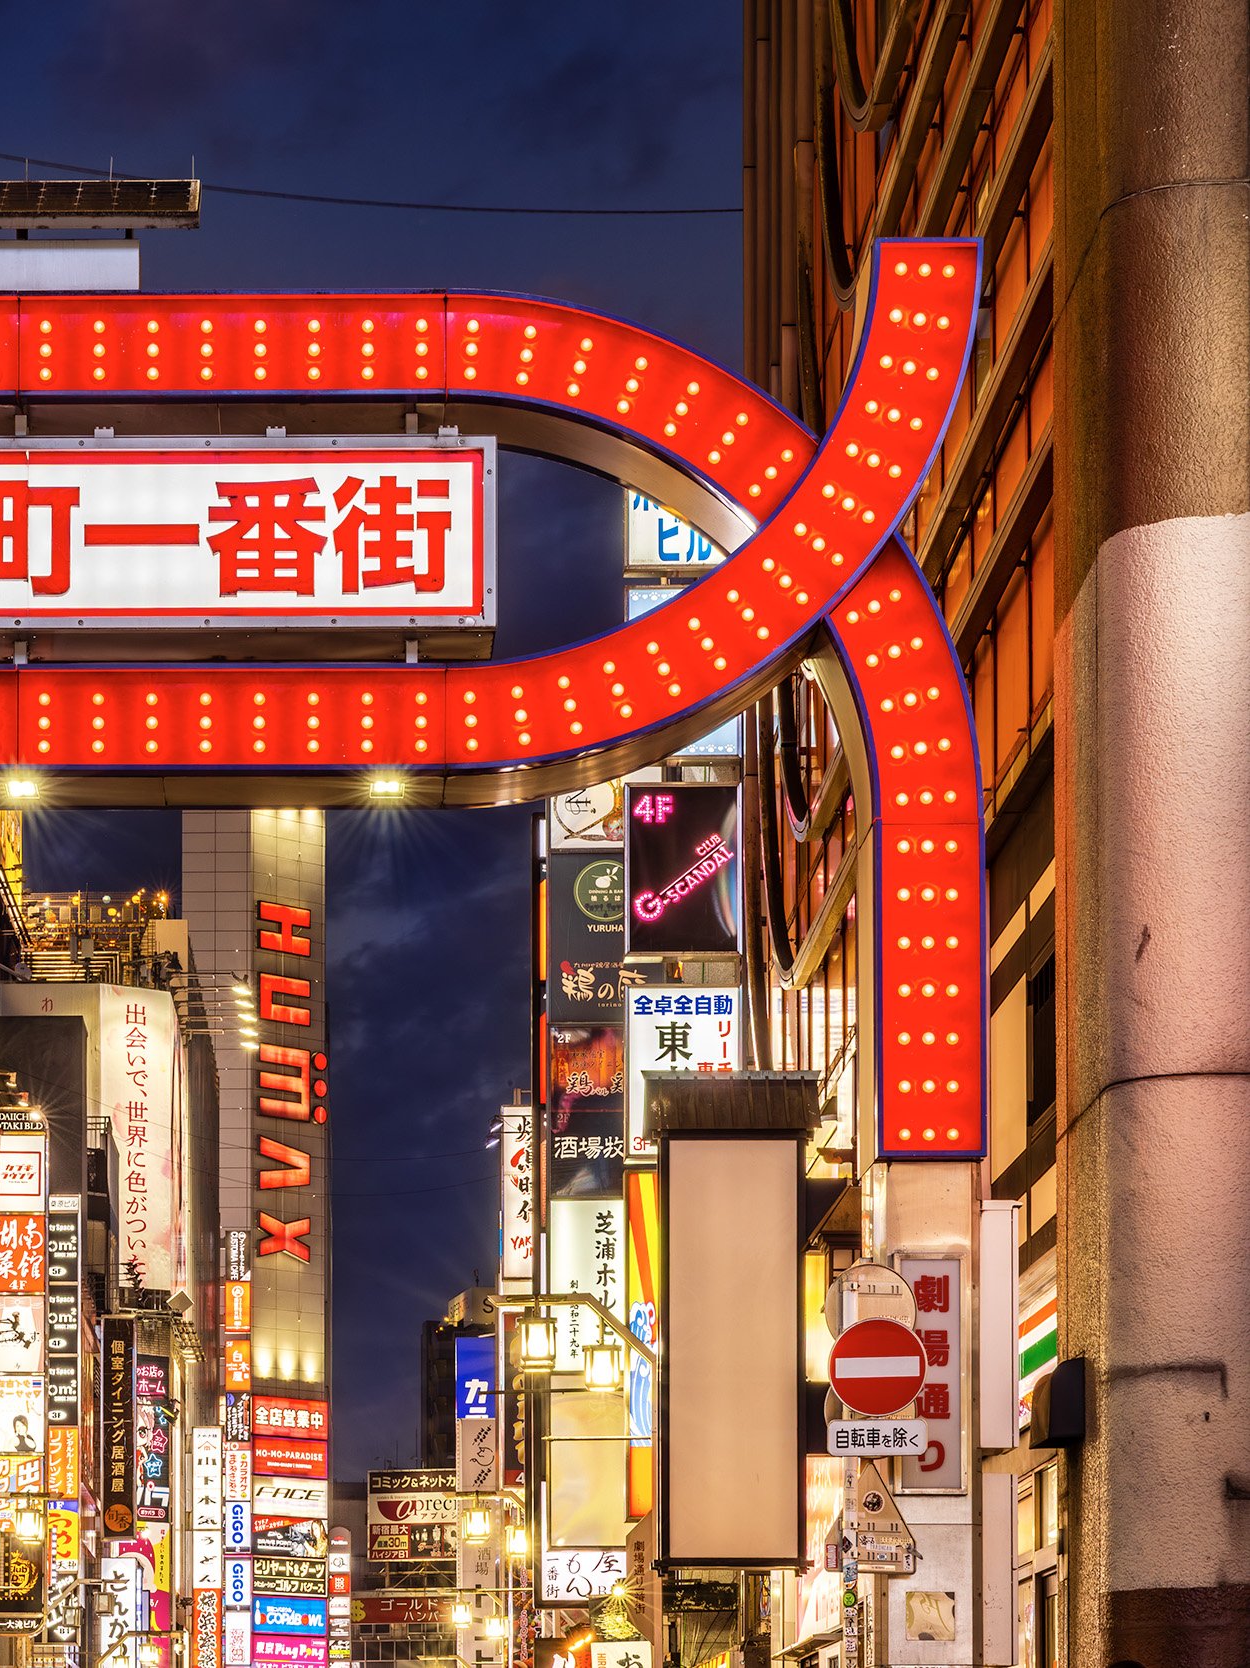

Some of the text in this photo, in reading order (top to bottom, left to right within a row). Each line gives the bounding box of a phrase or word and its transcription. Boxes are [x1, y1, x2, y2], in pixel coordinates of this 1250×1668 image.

[634, 795, 674, 823] 4F
[696, 833, 723, 857] CLUB
[634, 847, 735, 922] G-SCANDAL
[634, 995, 733, 1016] 全卓全自動
[557, 1034, 571, 1043] 2F
[654, 1021, 693, 1073] 東
[24, 1121, 44, 1130] BLD
[9, 1280, 28, 1290] 4F
[111, 1340, 126, 1493] 個室ダイニング居酒屋
[255, 1406, 324, 1430] 全店営業中
[835, 1427, 919, 1449] 自転車を除く
[255, 1487, 325, 1501] FACE
[232, 1504, 244, 1544] GiGO
[372, 1525, 409, 1535] 新宿最大
[371, 1550, 409, 1558] ハイジアB1
[475, 1546, 492, 1576] 酒場
[254, 1560, 325, 1578] ビリヤード&ダーツ
[633, 1540, 645, 1615] 劇場通り一番街
[232, 1563, 244, 1602] GiGO
